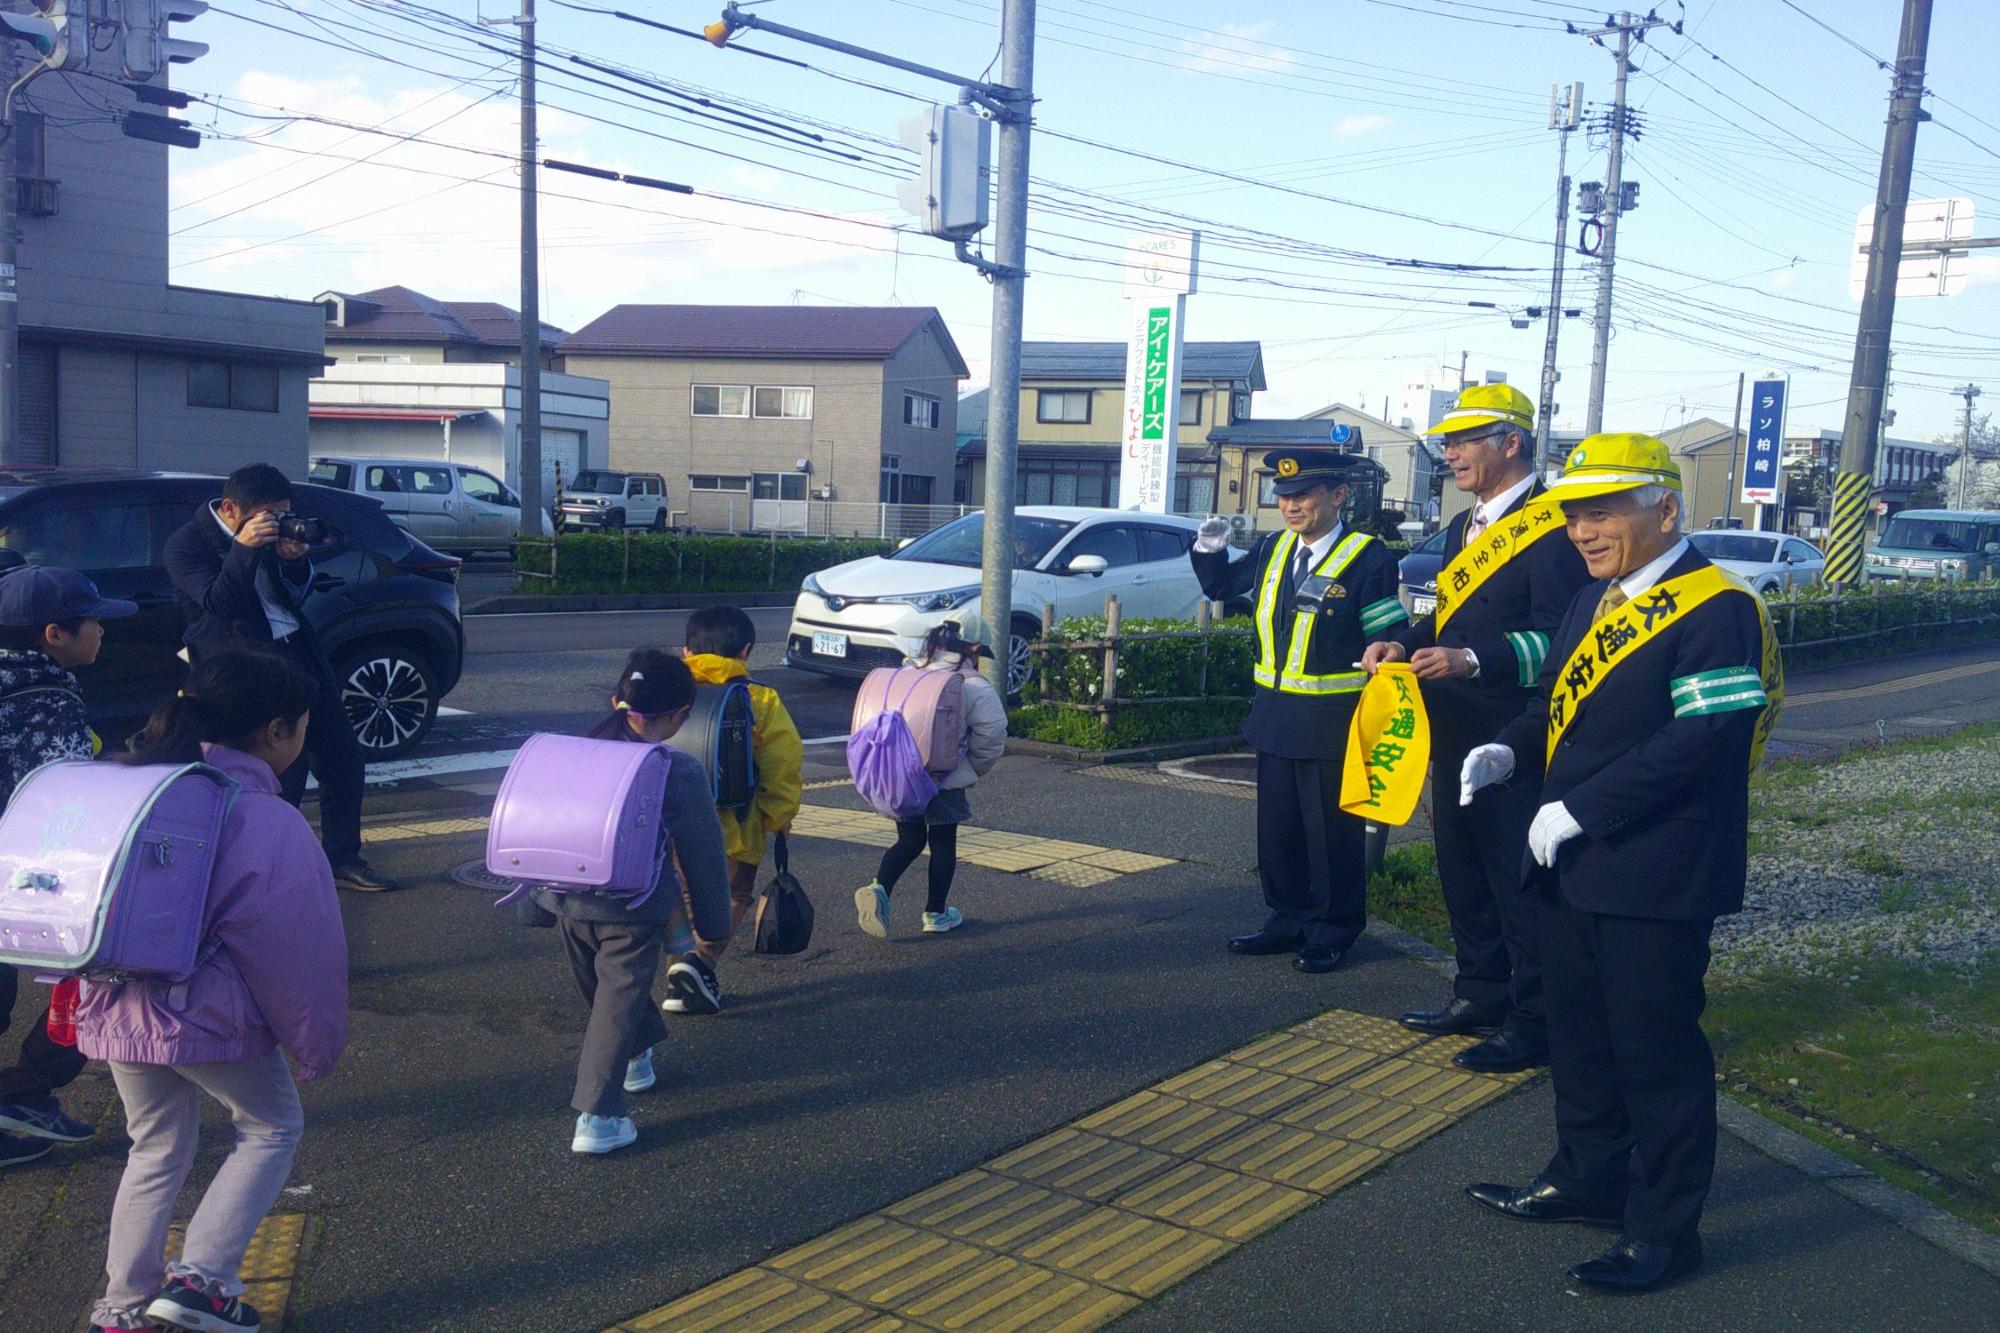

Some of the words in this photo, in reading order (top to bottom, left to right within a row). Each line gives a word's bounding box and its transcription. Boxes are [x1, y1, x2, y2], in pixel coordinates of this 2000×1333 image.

[1144, 316, 1169, 430] アイ・ケアーズ
[1128, 408, 1142, 458] ひよし
